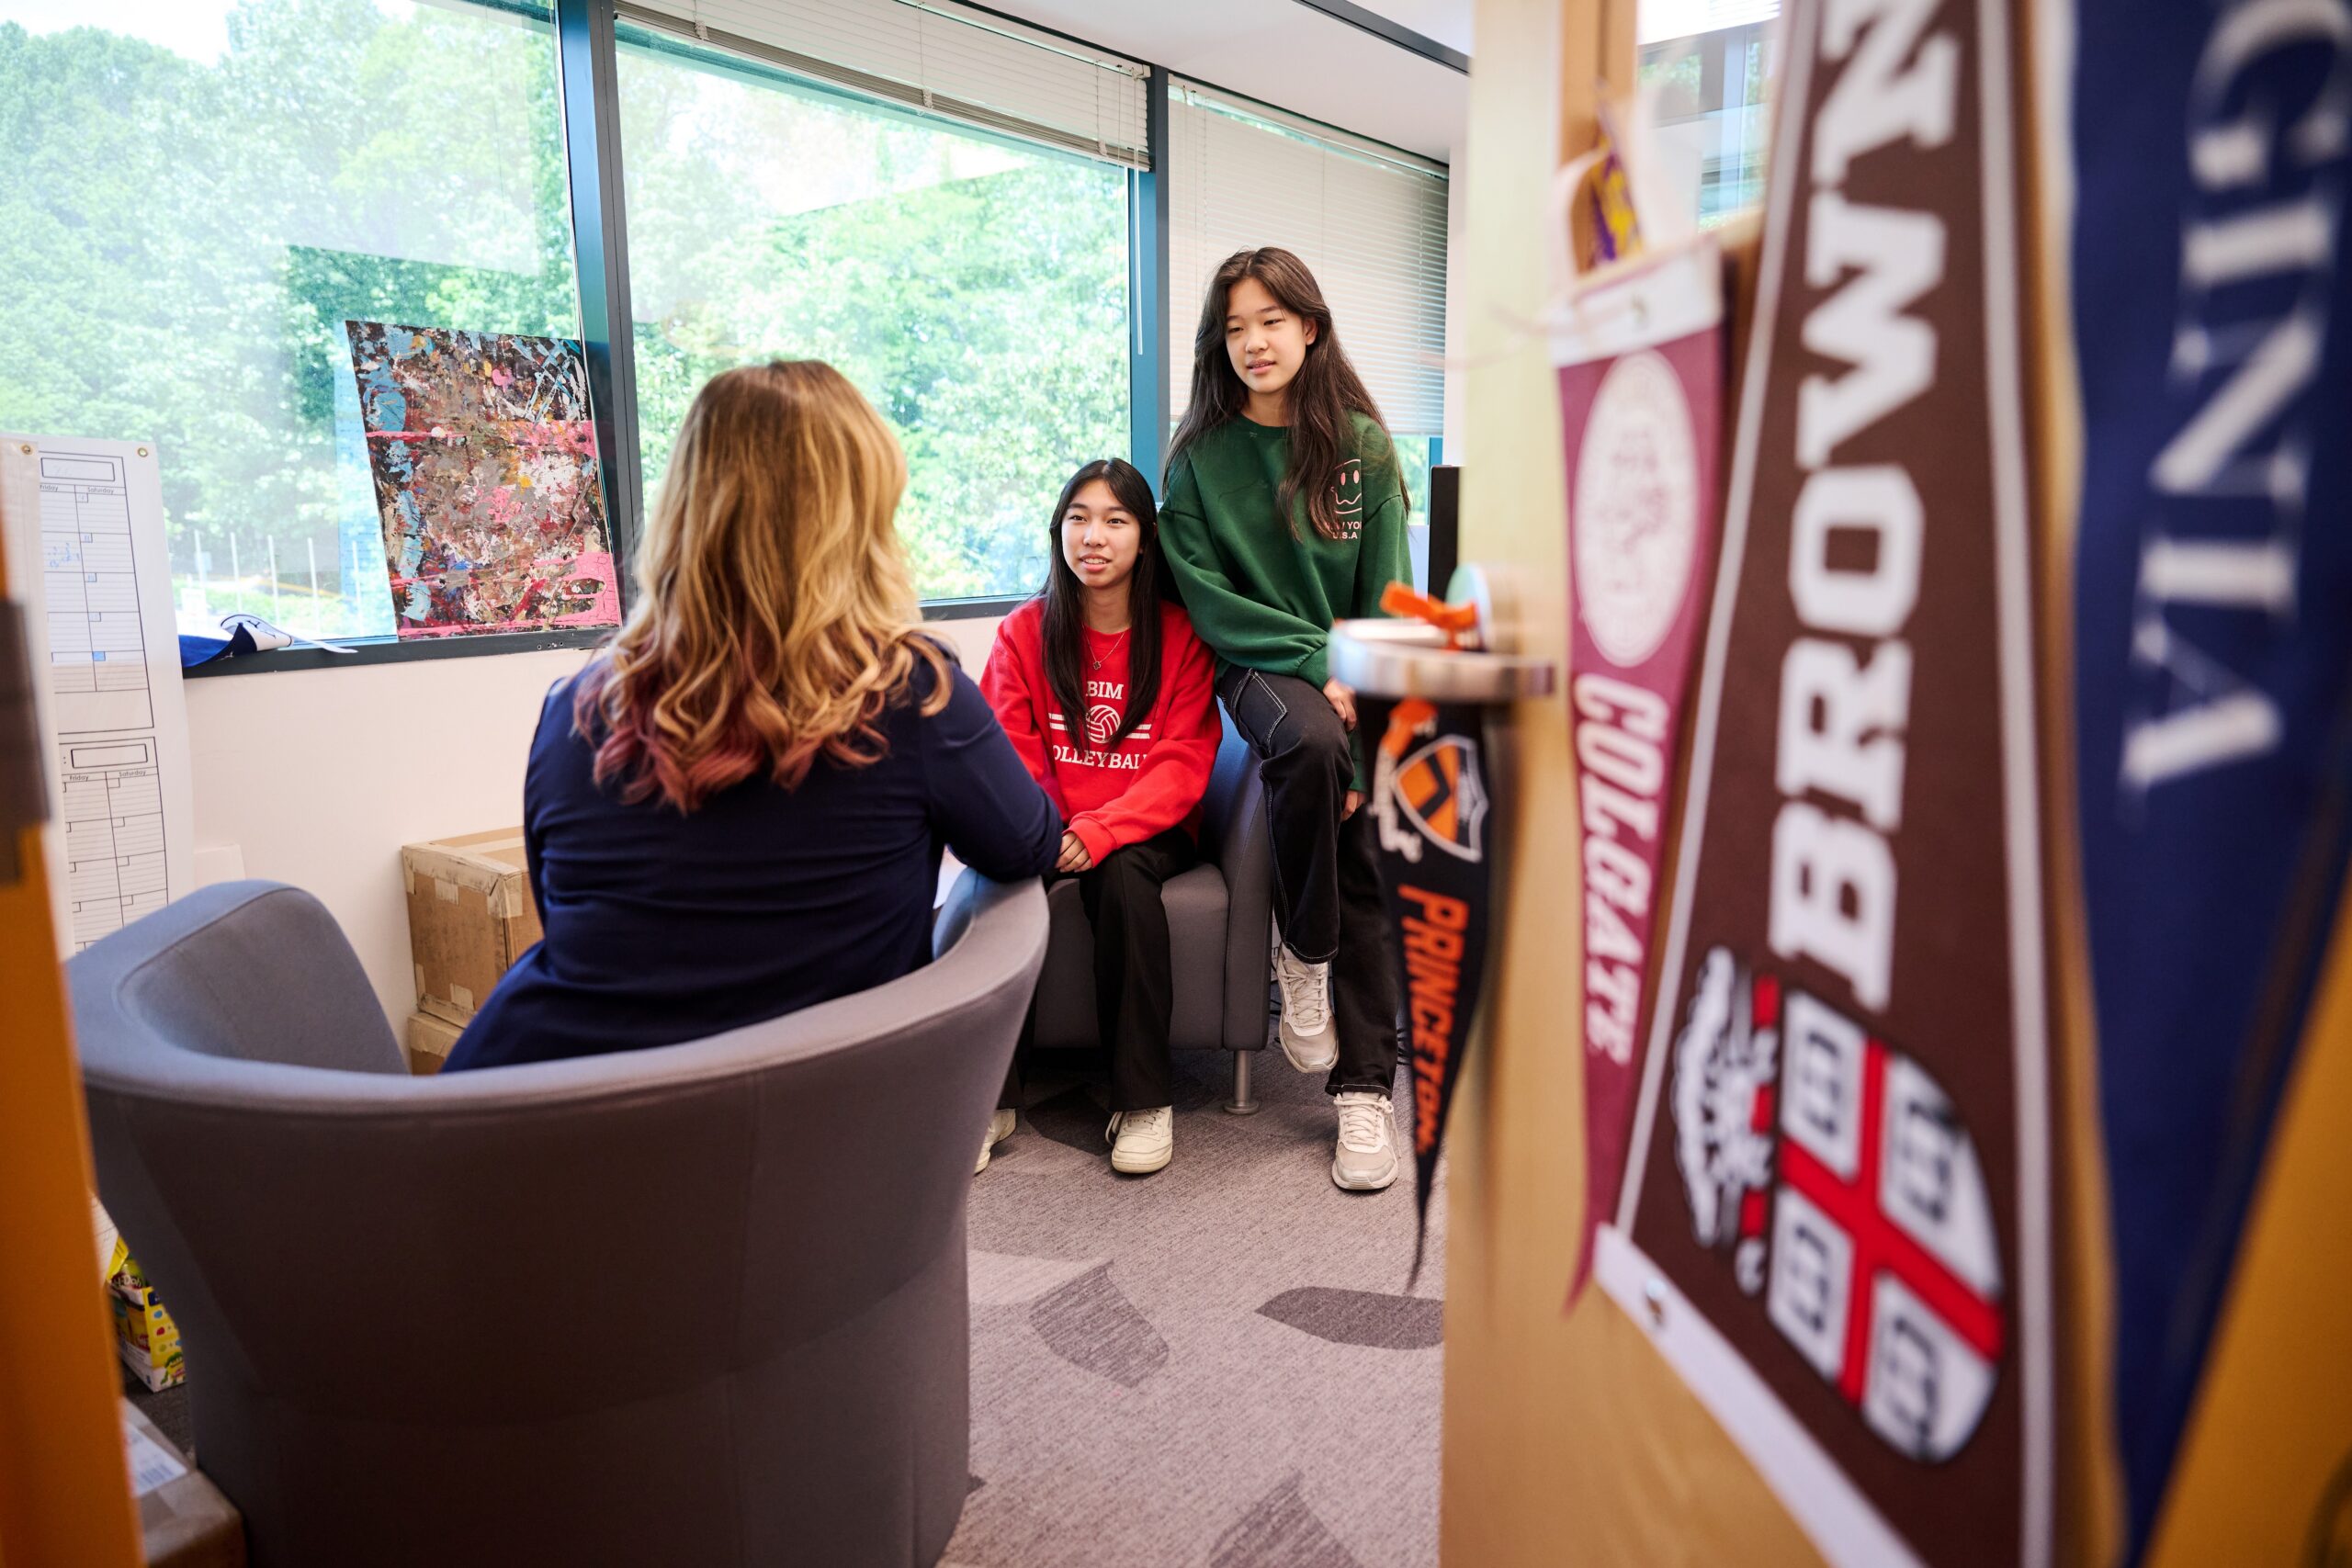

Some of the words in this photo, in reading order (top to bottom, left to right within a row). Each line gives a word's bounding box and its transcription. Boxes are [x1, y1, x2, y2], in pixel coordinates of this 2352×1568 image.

[1767, 0, 1960, 1014] BROWN
[119, 770, 146, 778] Saturday
[1052, 745, 1148, 770] OLLEYBAL
[1574, 673, 1669, 1066] COLGATE
[1397, 883, 1469, 1156] PRINCETON
